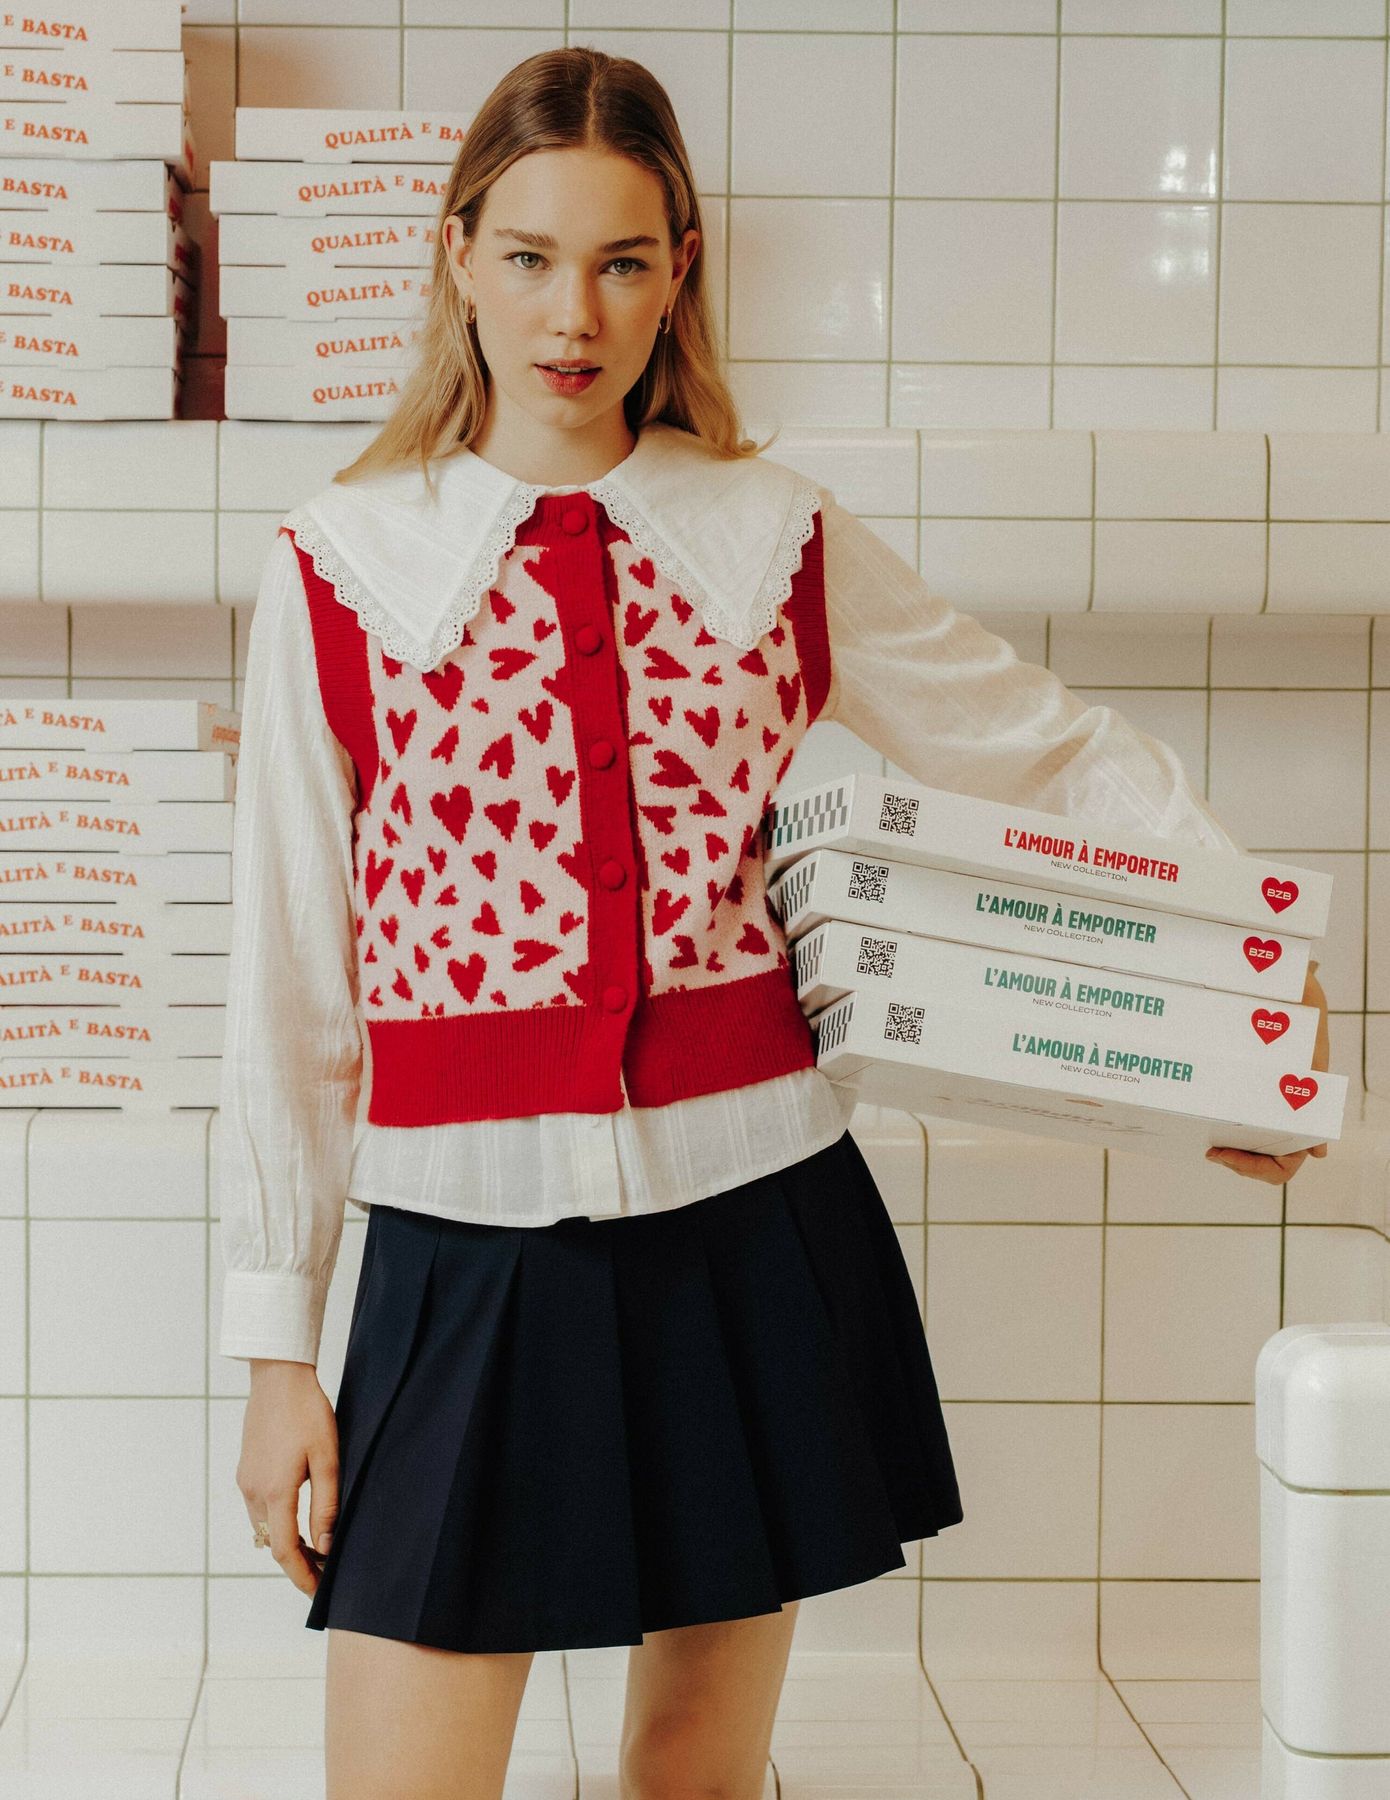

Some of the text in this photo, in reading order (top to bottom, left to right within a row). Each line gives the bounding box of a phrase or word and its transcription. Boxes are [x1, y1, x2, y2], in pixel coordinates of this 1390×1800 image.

[4, 14, 88, 42] E BASTA
[4, 64, 88, 92] E BASTA
[5, 118, 88, 145] E BASTA
[325, 122, 413, 150] QUALITÀ
[421, 122, 431, 134] E
[2, 177, 68, 201] BASTA
[297, 175, 387, 203] QUALITÀ
[395, 175, 404, 187] E
[9, 231, 75, 253] BASTA
[311, 226, 400, 254] QUALITÀ
[406, 226, 416, 238] E
[8, 283, 73, 305] BASTA
[306, 280, 395, 308] QUALITÀ
[13, 336, 79, 357] BASTA
[315, 332, 403, 358] QUALITÀ
[12, 384, 77, 406] BASTA
[312, 378, 401, 405] QUALITÀ
[24, 707, 34, 719] E
[42, 711, 105, 733] BASTA
[48, 762, 58, 773] E
[66, 764, 130, 786] BASTA
[59, 810, 69, 822] E
[76, 814, 141, 836] BASTA
[1004, 827, 1180, 882] L'AMOUR À EMPORTER
[0, 862, 138, 887] LITÀ E BASTA
[1051, 859, 1128, 882] NEW COLLECTION
[1266, 887, 1292, 902] BZB
[63, 914, 73, 926] E
[80, 918, 145, 939] BASTA
[976, 892, 1157, 944] L'AMOUR À EMPORTER
[1024, 923, 1105, 945] NEW COLLECTION
[1248, 946, 1274, 961] BZB
[60, 964, 70, 976] E
[78, 968, 142, 989] BASTA
[983, 966, 1165, 1017] L'AMOUR À EMPORTER
[1032, 997, 1113, 1018] NEW COLLECTION
[0, 1018, 151, 1042] ALITÀ E BASTA
[1256, 1018, 1282, 1033] BZB
[1011, 1032, 1194, 1083] L'AMOUR À EMPORTER
[61, 1067, 71, 1079] E
[79, 1071, 143, 1091] BASTA
[1060, 1063, 1141, 1085] NEW COLLECTION
[1284, 1084, 1311, 1099] BZB
